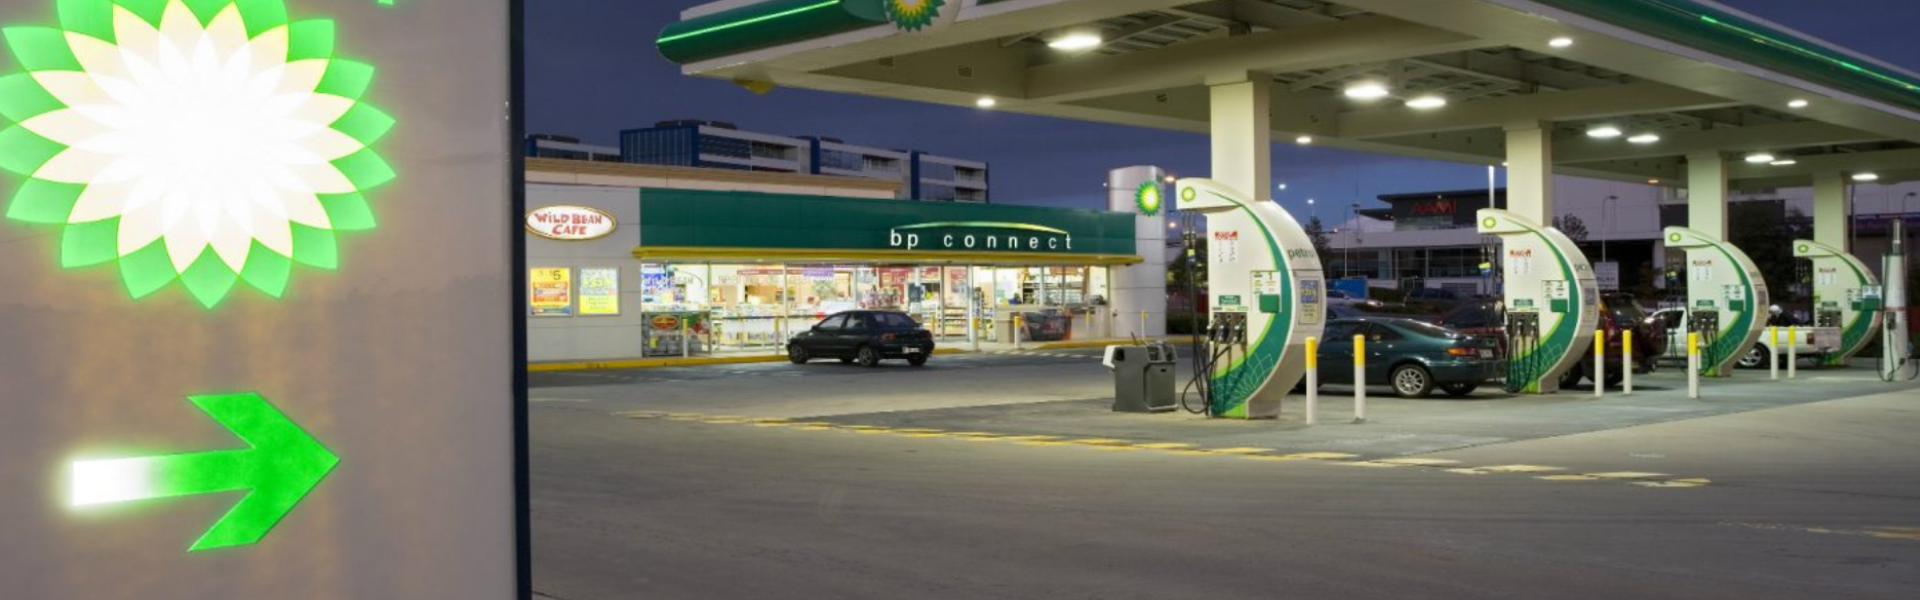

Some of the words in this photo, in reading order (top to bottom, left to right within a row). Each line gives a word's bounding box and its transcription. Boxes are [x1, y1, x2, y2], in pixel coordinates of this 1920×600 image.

[571, 213, 602, 224] BEAN
[552, 224, 587, 235] CAFE
[890, 229, 919, 250] bp
[943, 233, 1072, 249] connect
